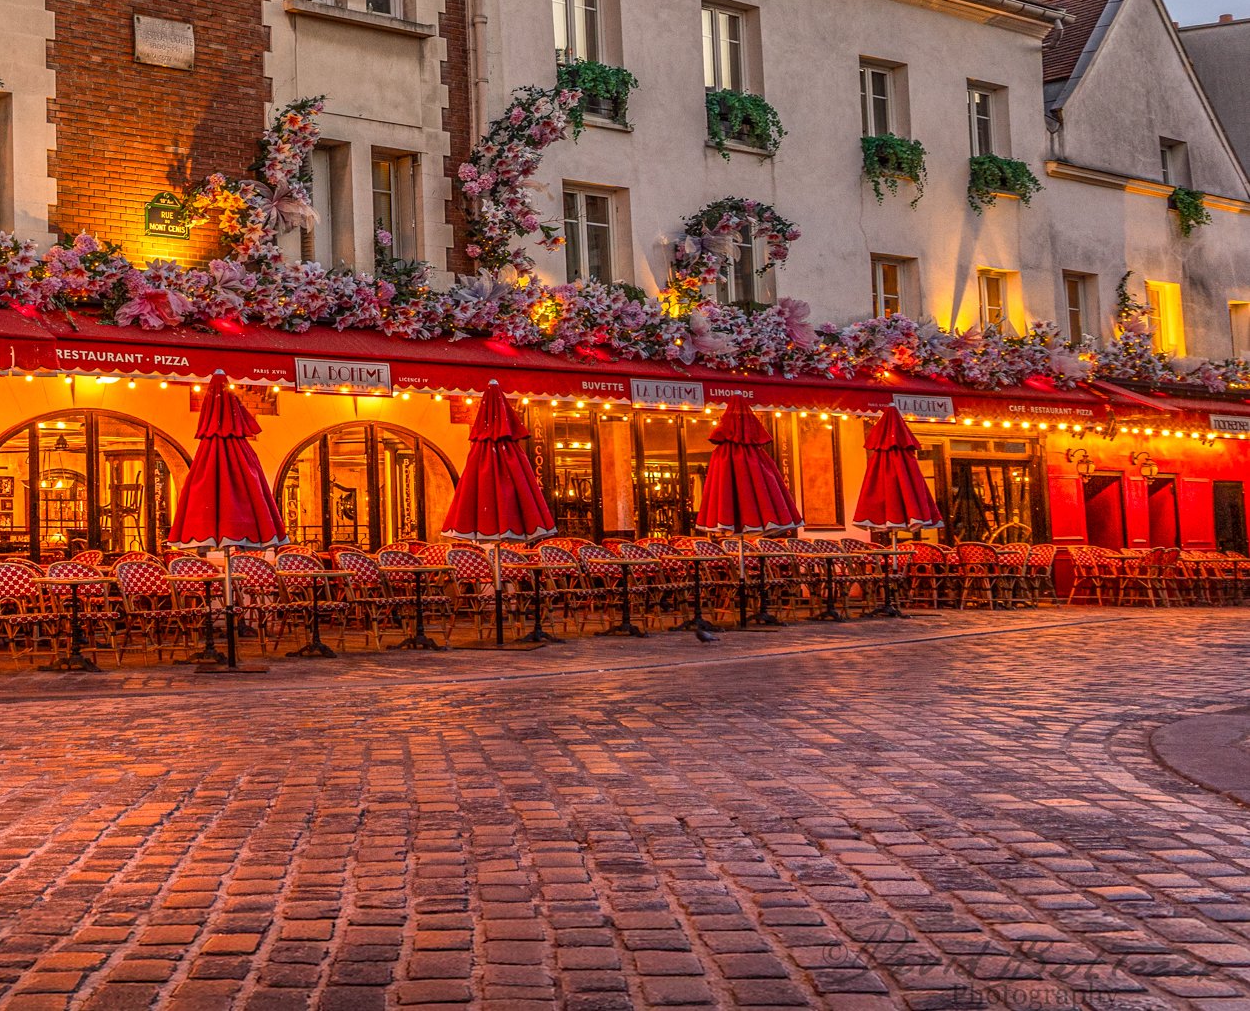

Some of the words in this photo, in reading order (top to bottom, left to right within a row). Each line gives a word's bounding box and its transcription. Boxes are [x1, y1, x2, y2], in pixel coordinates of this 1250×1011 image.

[161, 211, 174, 220] RUE
[149, 222, 166, 232] MONT
[168, 225, 186, 234] CENIS
[55, 348, 143, 364] RESTAURANT
[154, 355, 190, 367] PIZZA
[304, 364, 321, 379] LA
[328, 366, 385, 383] BOHEME
[582, 381, 625, 392] BUVETTE
[636, 384, 650, 397] LA
[655, 385, 699, 400] BOHEME
[897, 399, 908, 411] LA
[1008, 405, 1026, 413] CAFE
[1030, 406, 1072, 415] RESTAURANT
[1076, 408, 1094, 417] PIZZA
[533, 407, 543, 439] BAR
